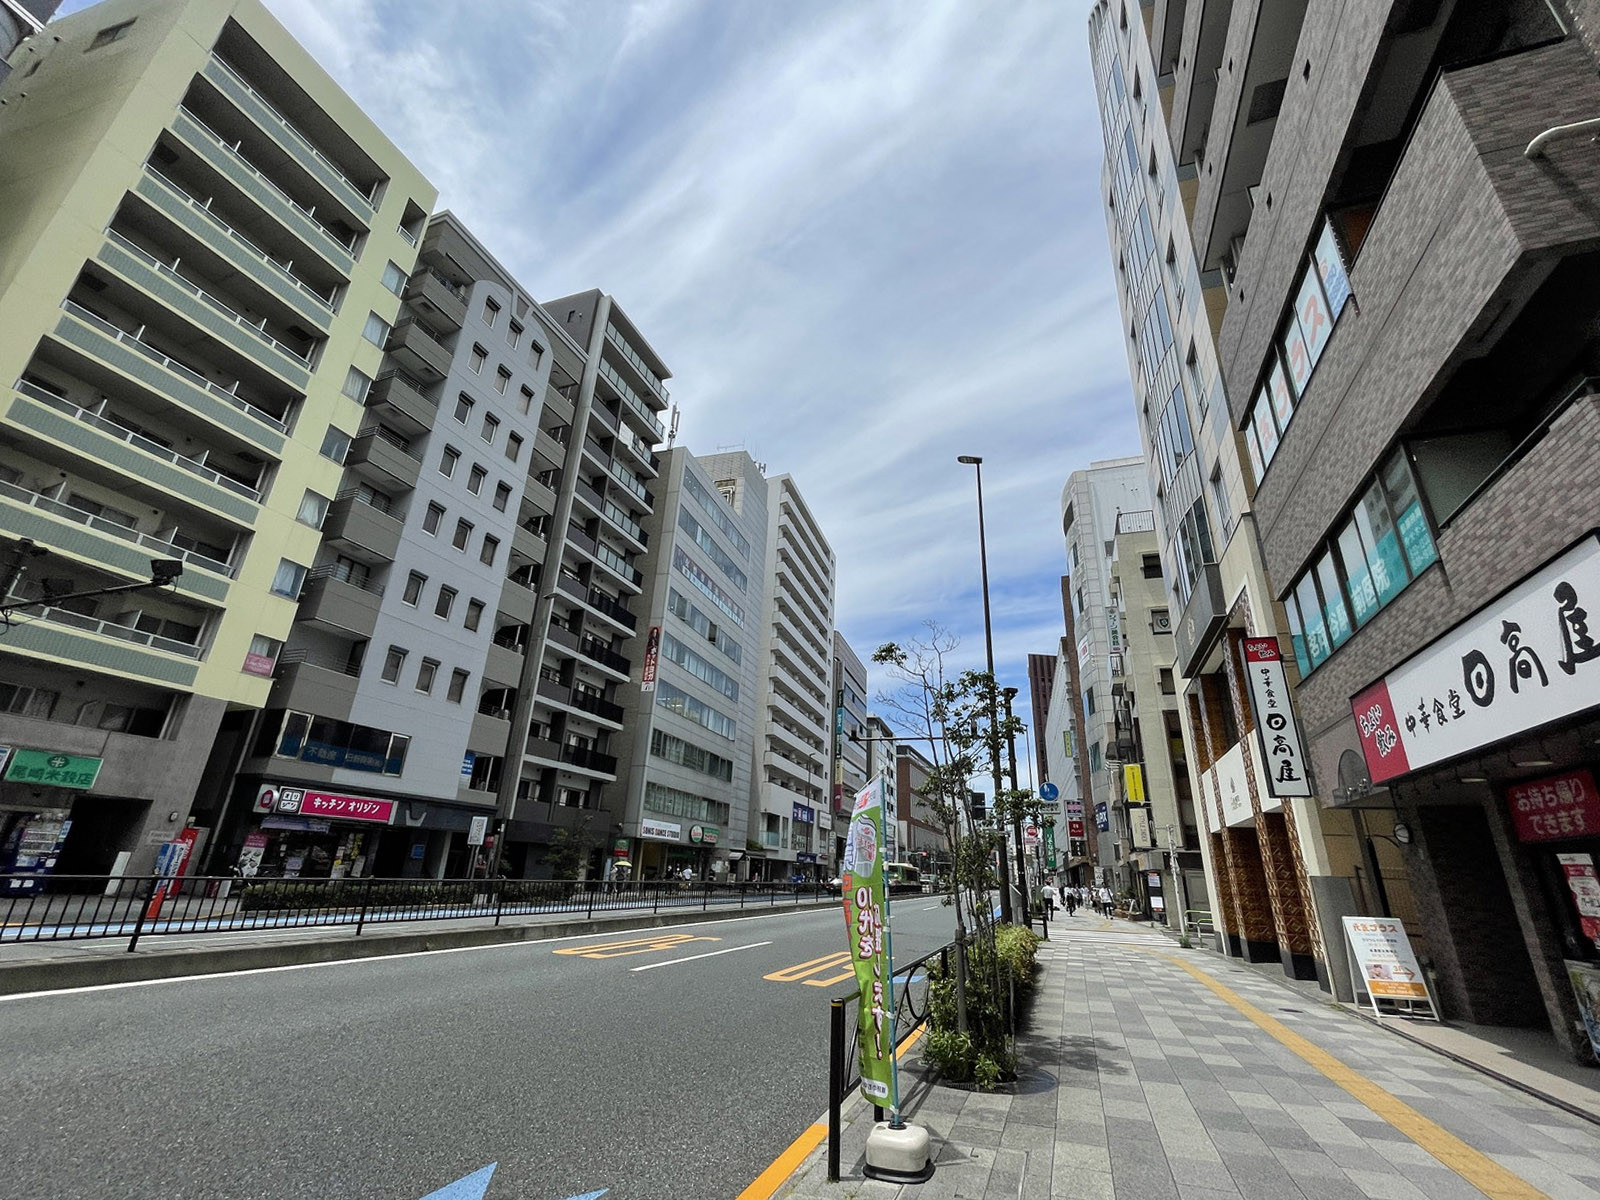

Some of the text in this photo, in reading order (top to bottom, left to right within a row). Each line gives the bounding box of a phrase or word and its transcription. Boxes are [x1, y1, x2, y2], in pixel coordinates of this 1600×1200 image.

[1404, 581, 1600, 738] 中華食堂 日高屋
[1260, 668, 1302, 784] 中華食堂 日高屋
[1358, 702, 1384, 739] ちょい
[1375, 724, 1398, 758] 飲み
[313, 797, 381, 814] キッチン オリジン
[1528, 807, 1586, 834] できます
